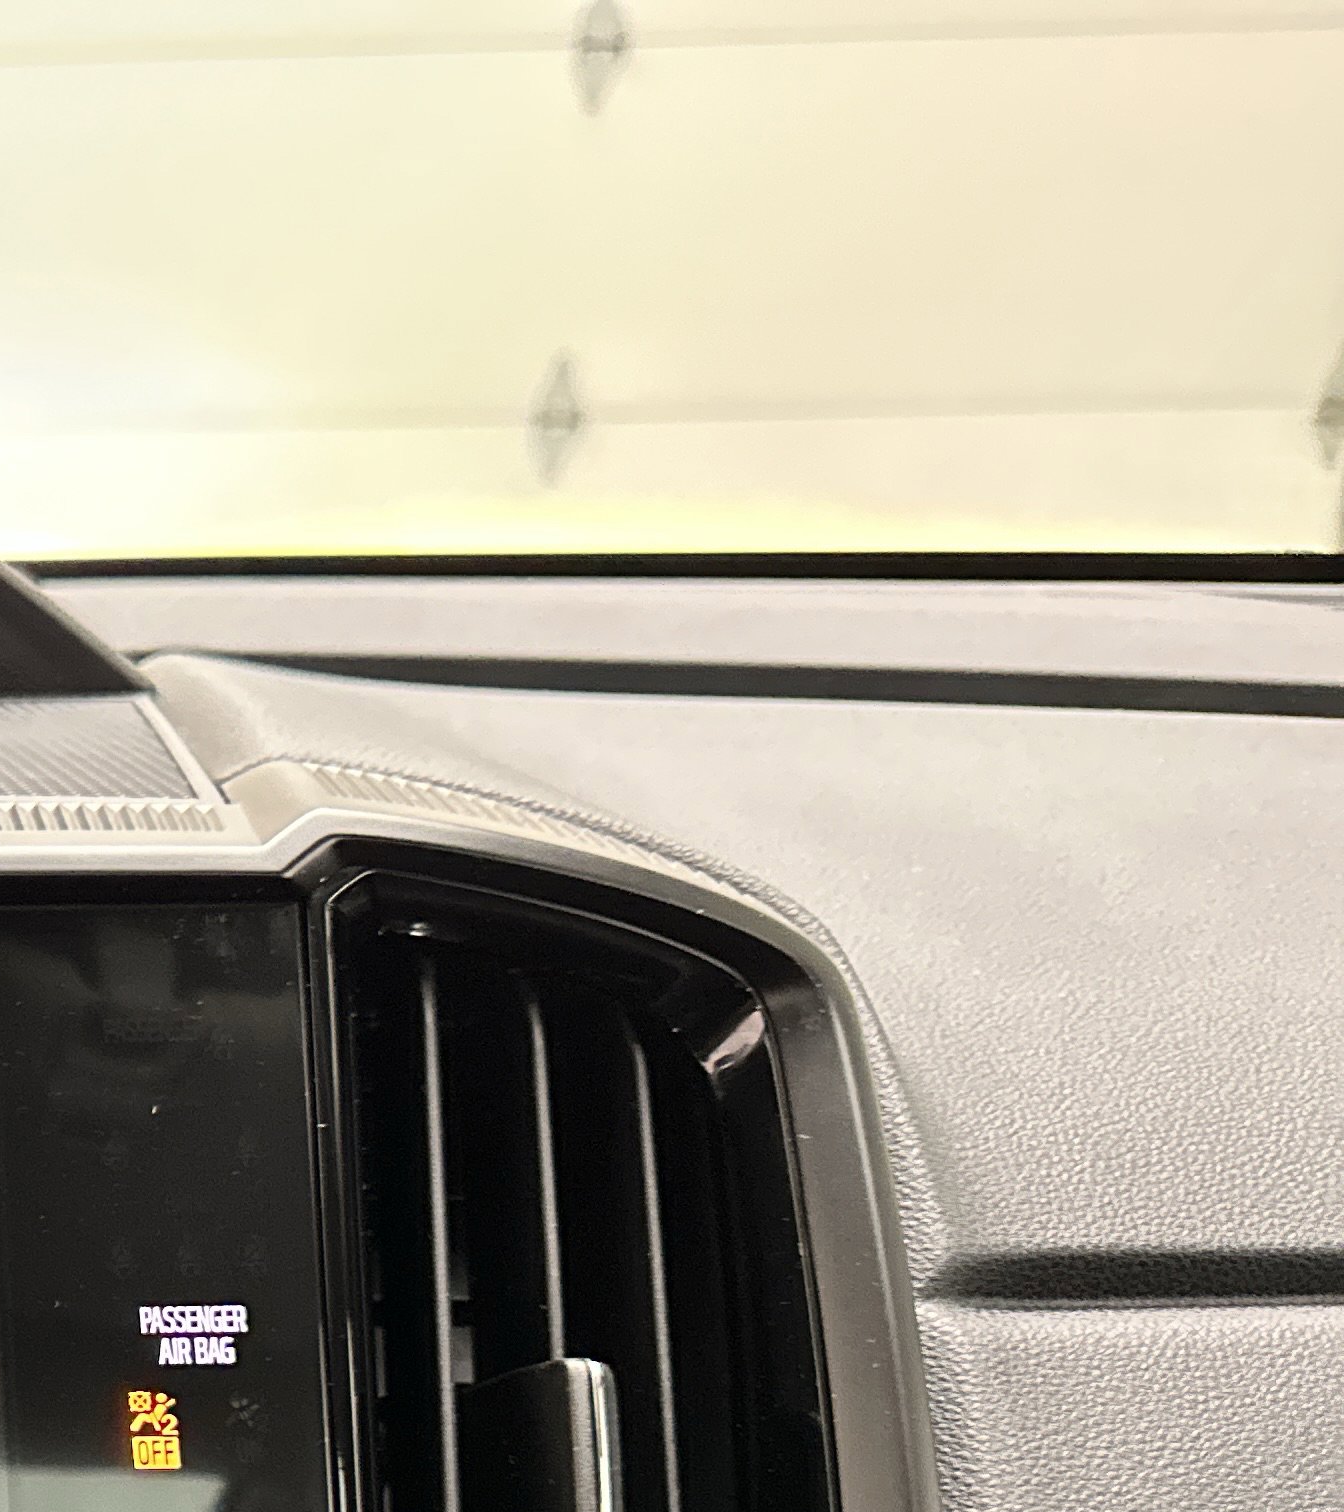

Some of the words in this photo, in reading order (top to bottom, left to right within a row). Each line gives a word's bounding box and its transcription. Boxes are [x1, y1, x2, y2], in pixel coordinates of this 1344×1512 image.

[139, 1304, 249, 1334] PASSENGER
[159, 1337, 193, 1365] AIR
[194, 1336, 237, 1365] BAG
[137, 1440, 174, 1465] OFF
